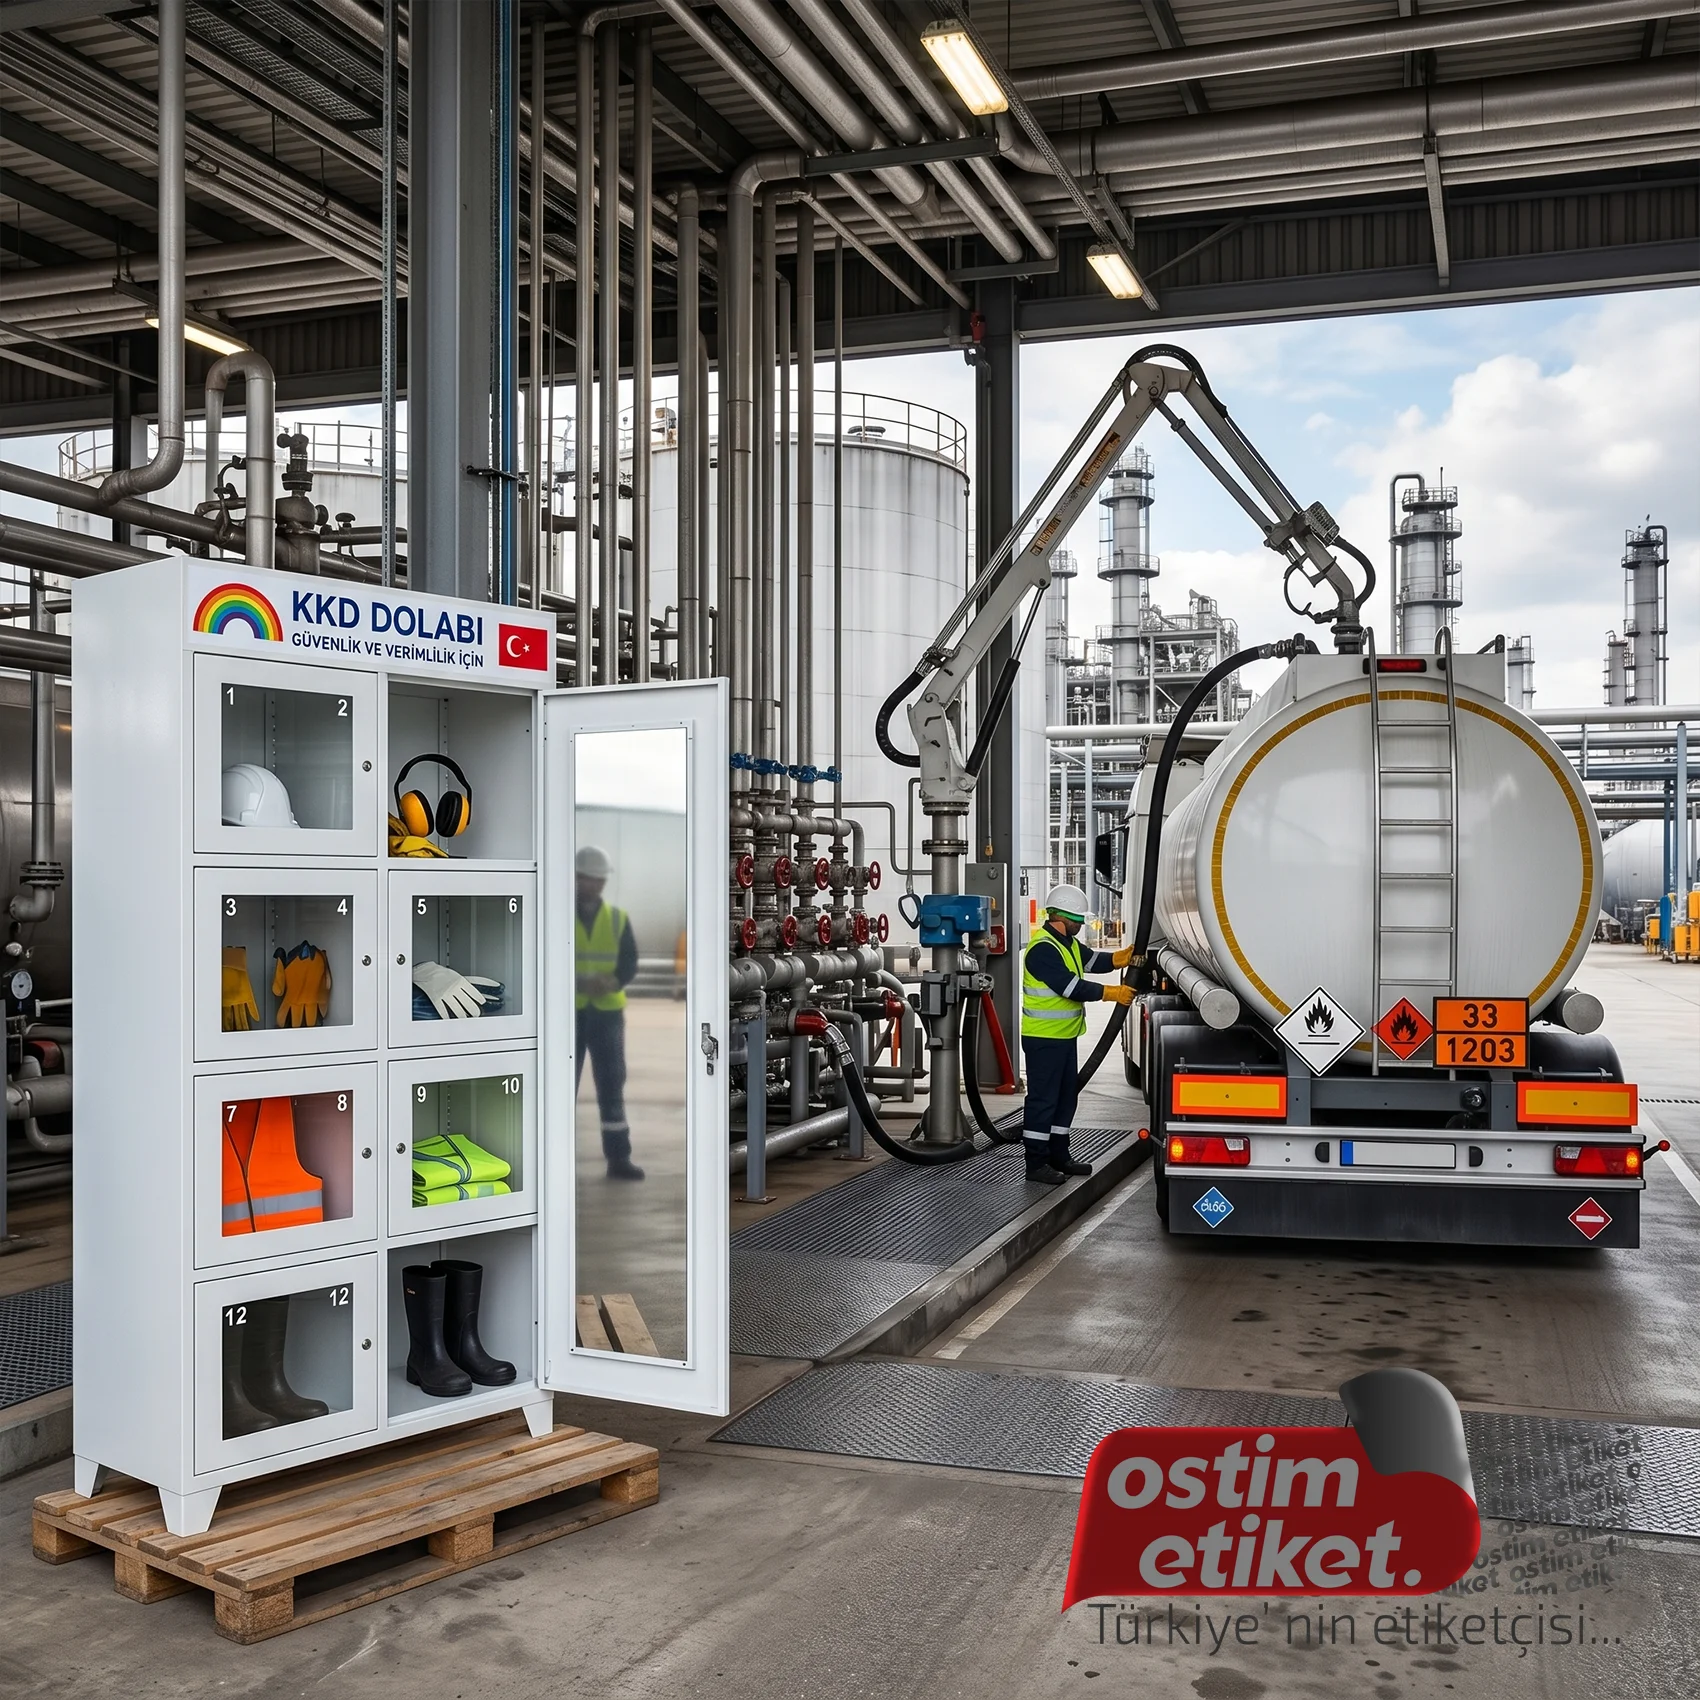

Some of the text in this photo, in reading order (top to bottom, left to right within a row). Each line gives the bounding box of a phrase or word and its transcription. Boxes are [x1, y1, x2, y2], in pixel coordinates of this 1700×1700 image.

[292, 590, 484, 646] KKD DOLABI
[291, 629, 484, 670] GÜVENLİK VE VERİMLİLİK İÇİN
[226, 687, 235, 706] 1
[337, 698, 349, 718] 2
[225, 898, 237, 917] 3
[336, 898, 349, 917] 4
[417, 898, 427, 916] 5
[508, 897, 518, 915] 6
[1462, 1002, 1498, 1029] 33
[1447, 1036, 1516, 1063] 1203
[416, 1085, 427, 1103] 9
[501, 1077, 520, 1096] 10
[336, 1093, 348, 1112] 8
[226, 1104, 238, 1123] 7
[329, 1286, 350, 1308] 12
[225, 1305, 248, 1327] 12
